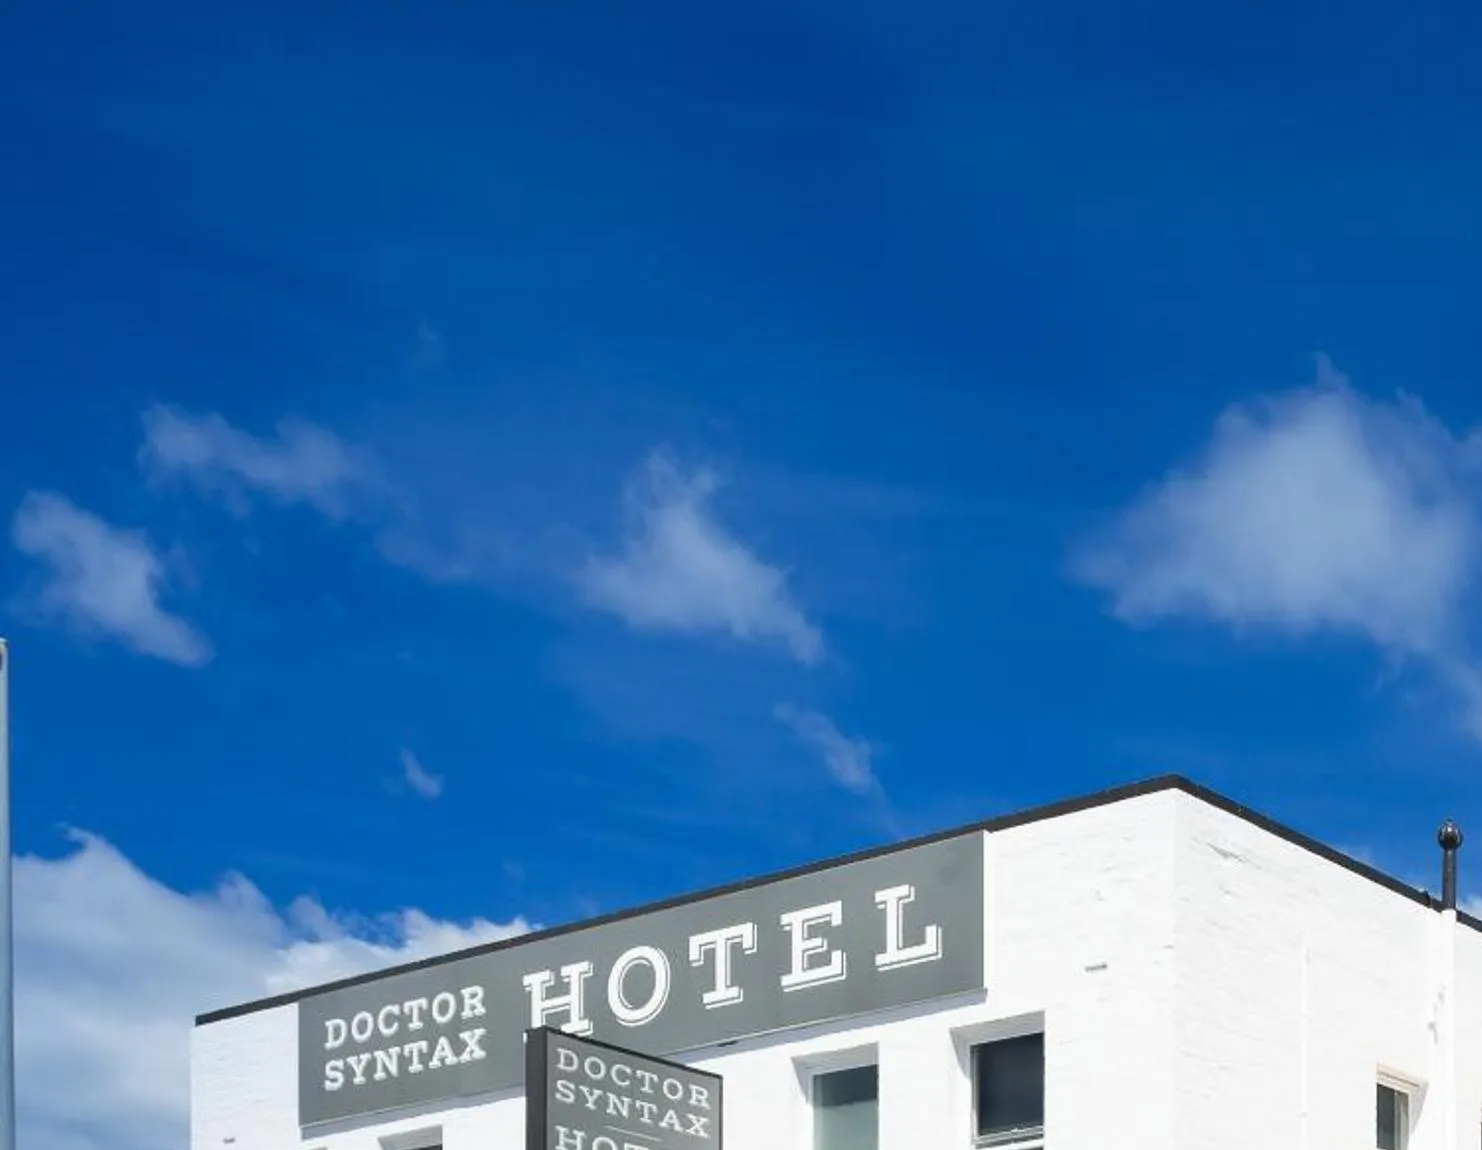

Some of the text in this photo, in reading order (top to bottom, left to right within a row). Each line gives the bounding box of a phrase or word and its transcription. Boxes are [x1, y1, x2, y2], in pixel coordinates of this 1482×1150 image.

[521, 883, 943, 1037] HOTEL
[324, 985, 487, 1051] DOCTOR
[323, 1028, 487, 1091] SYNTAX
[556, 1048, 711, 1110] DOCTOR
[555, 1080, 711, 1138] SYNTAX
